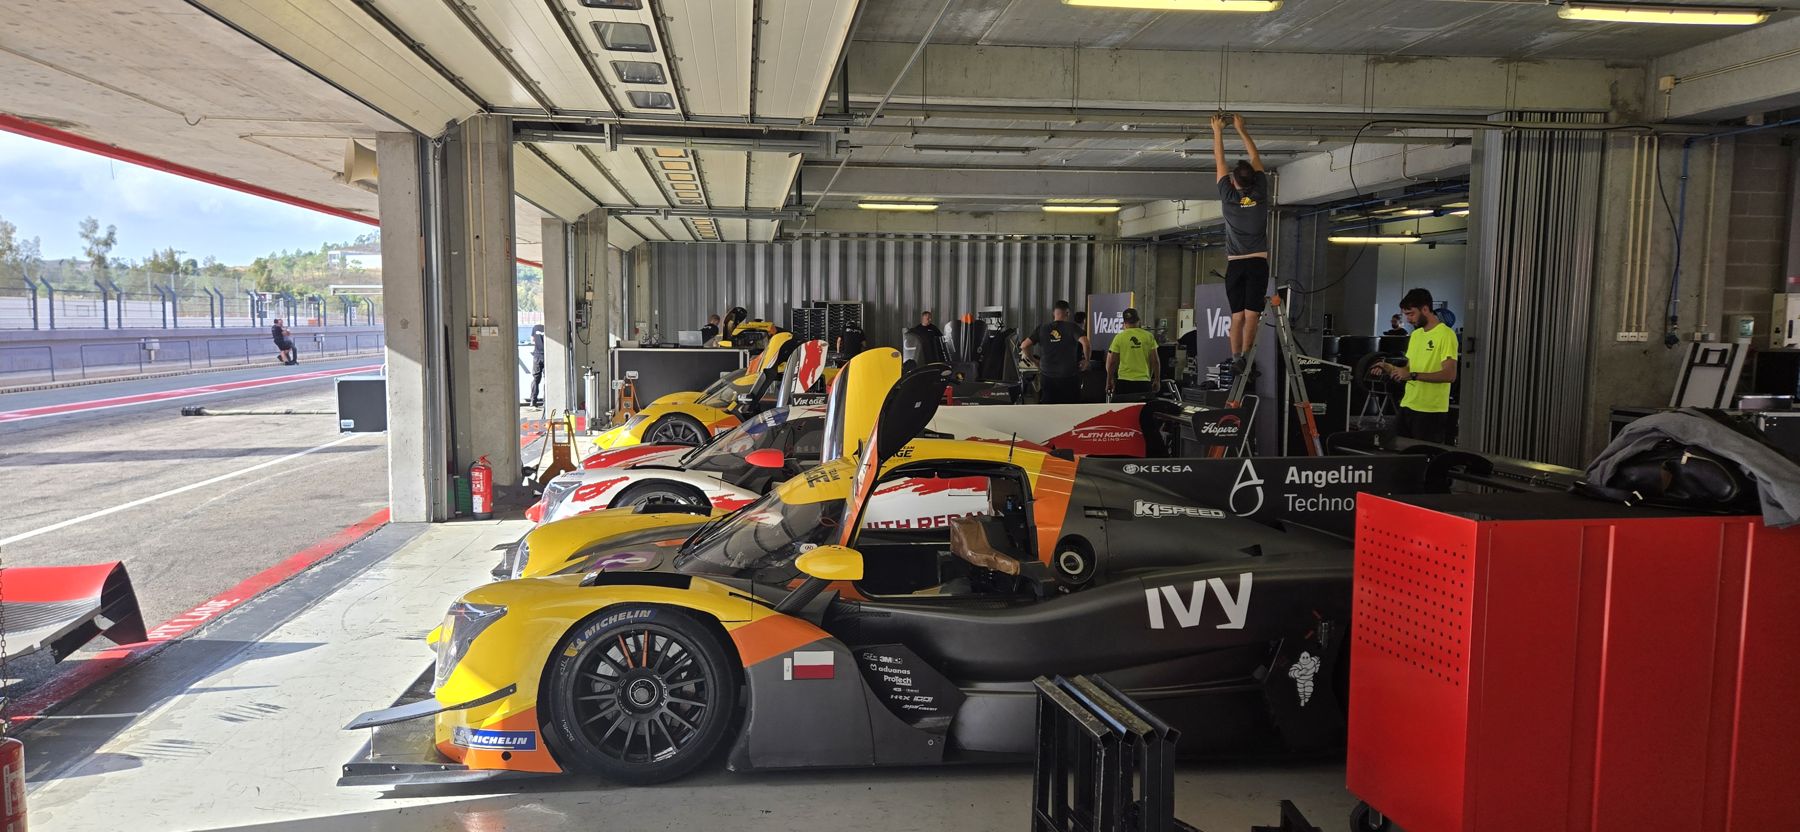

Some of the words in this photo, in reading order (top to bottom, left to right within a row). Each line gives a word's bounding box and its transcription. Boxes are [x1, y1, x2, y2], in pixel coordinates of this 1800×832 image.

[1206, 308, 1232, 339] VIR
[1139, 464, 1193, 473] KEKSA
[1285, 465, 1373, 487] Angelini
[1284, 493, 1355, 512] Techno
[584, 609, 652, 639] MICHELIN
[878, 666, 911, 675] aduanas
[883, 675, 912, 685] ProTech
[468, 734, 528, 745] MICHELIN
